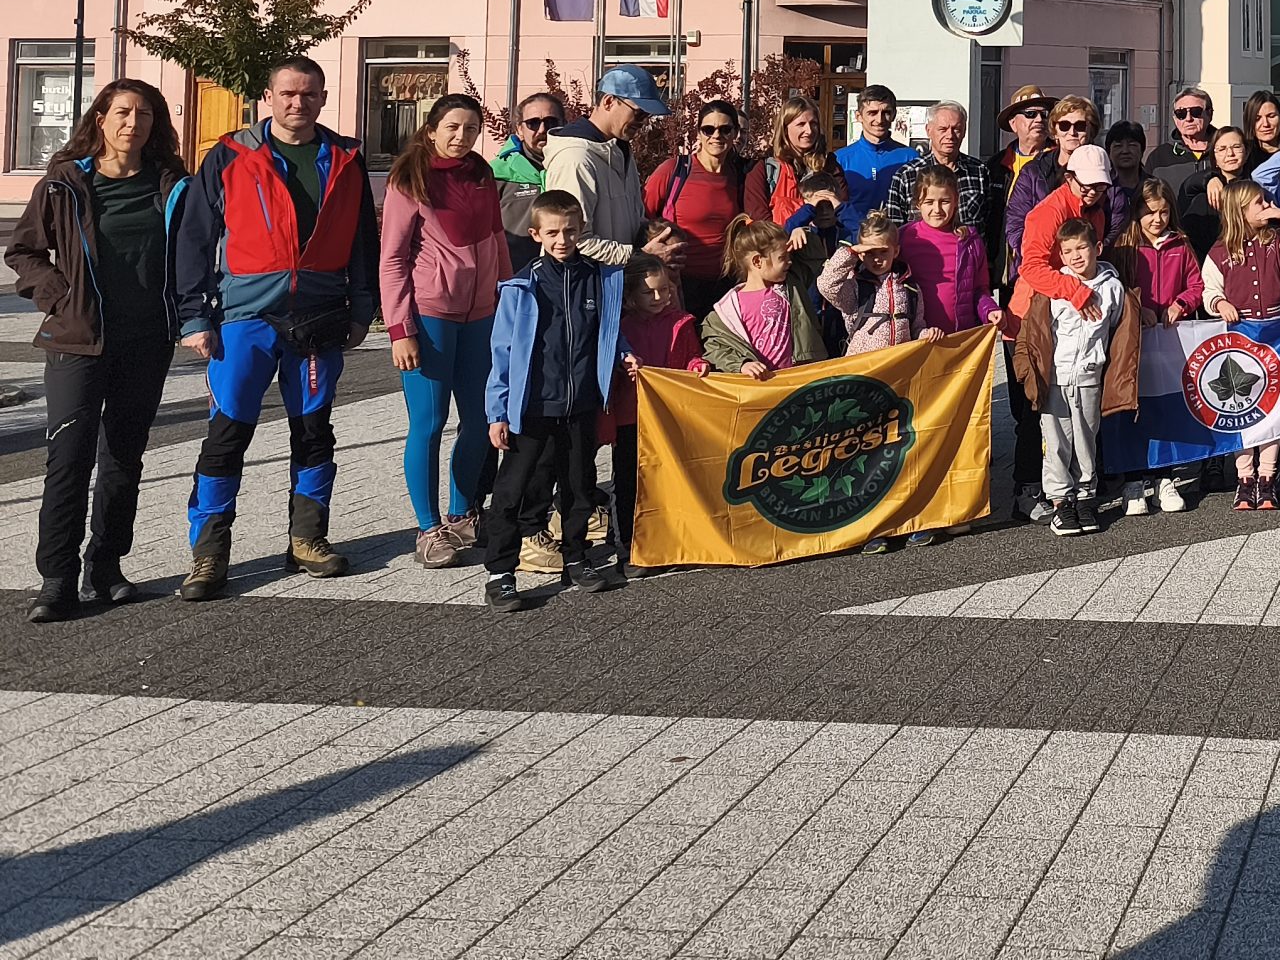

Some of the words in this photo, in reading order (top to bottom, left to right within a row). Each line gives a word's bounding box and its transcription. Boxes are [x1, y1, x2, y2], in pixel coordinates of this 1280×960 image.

[1244, 342, 1279, 393] JANKOVAC
[1217, 410, 1262, 427] OSIJEK
[1221, 396, 1253, 411] 1895
[736, 409, 903, 491] Legosi
[827, 448, 895, 520] JANKOVAC
